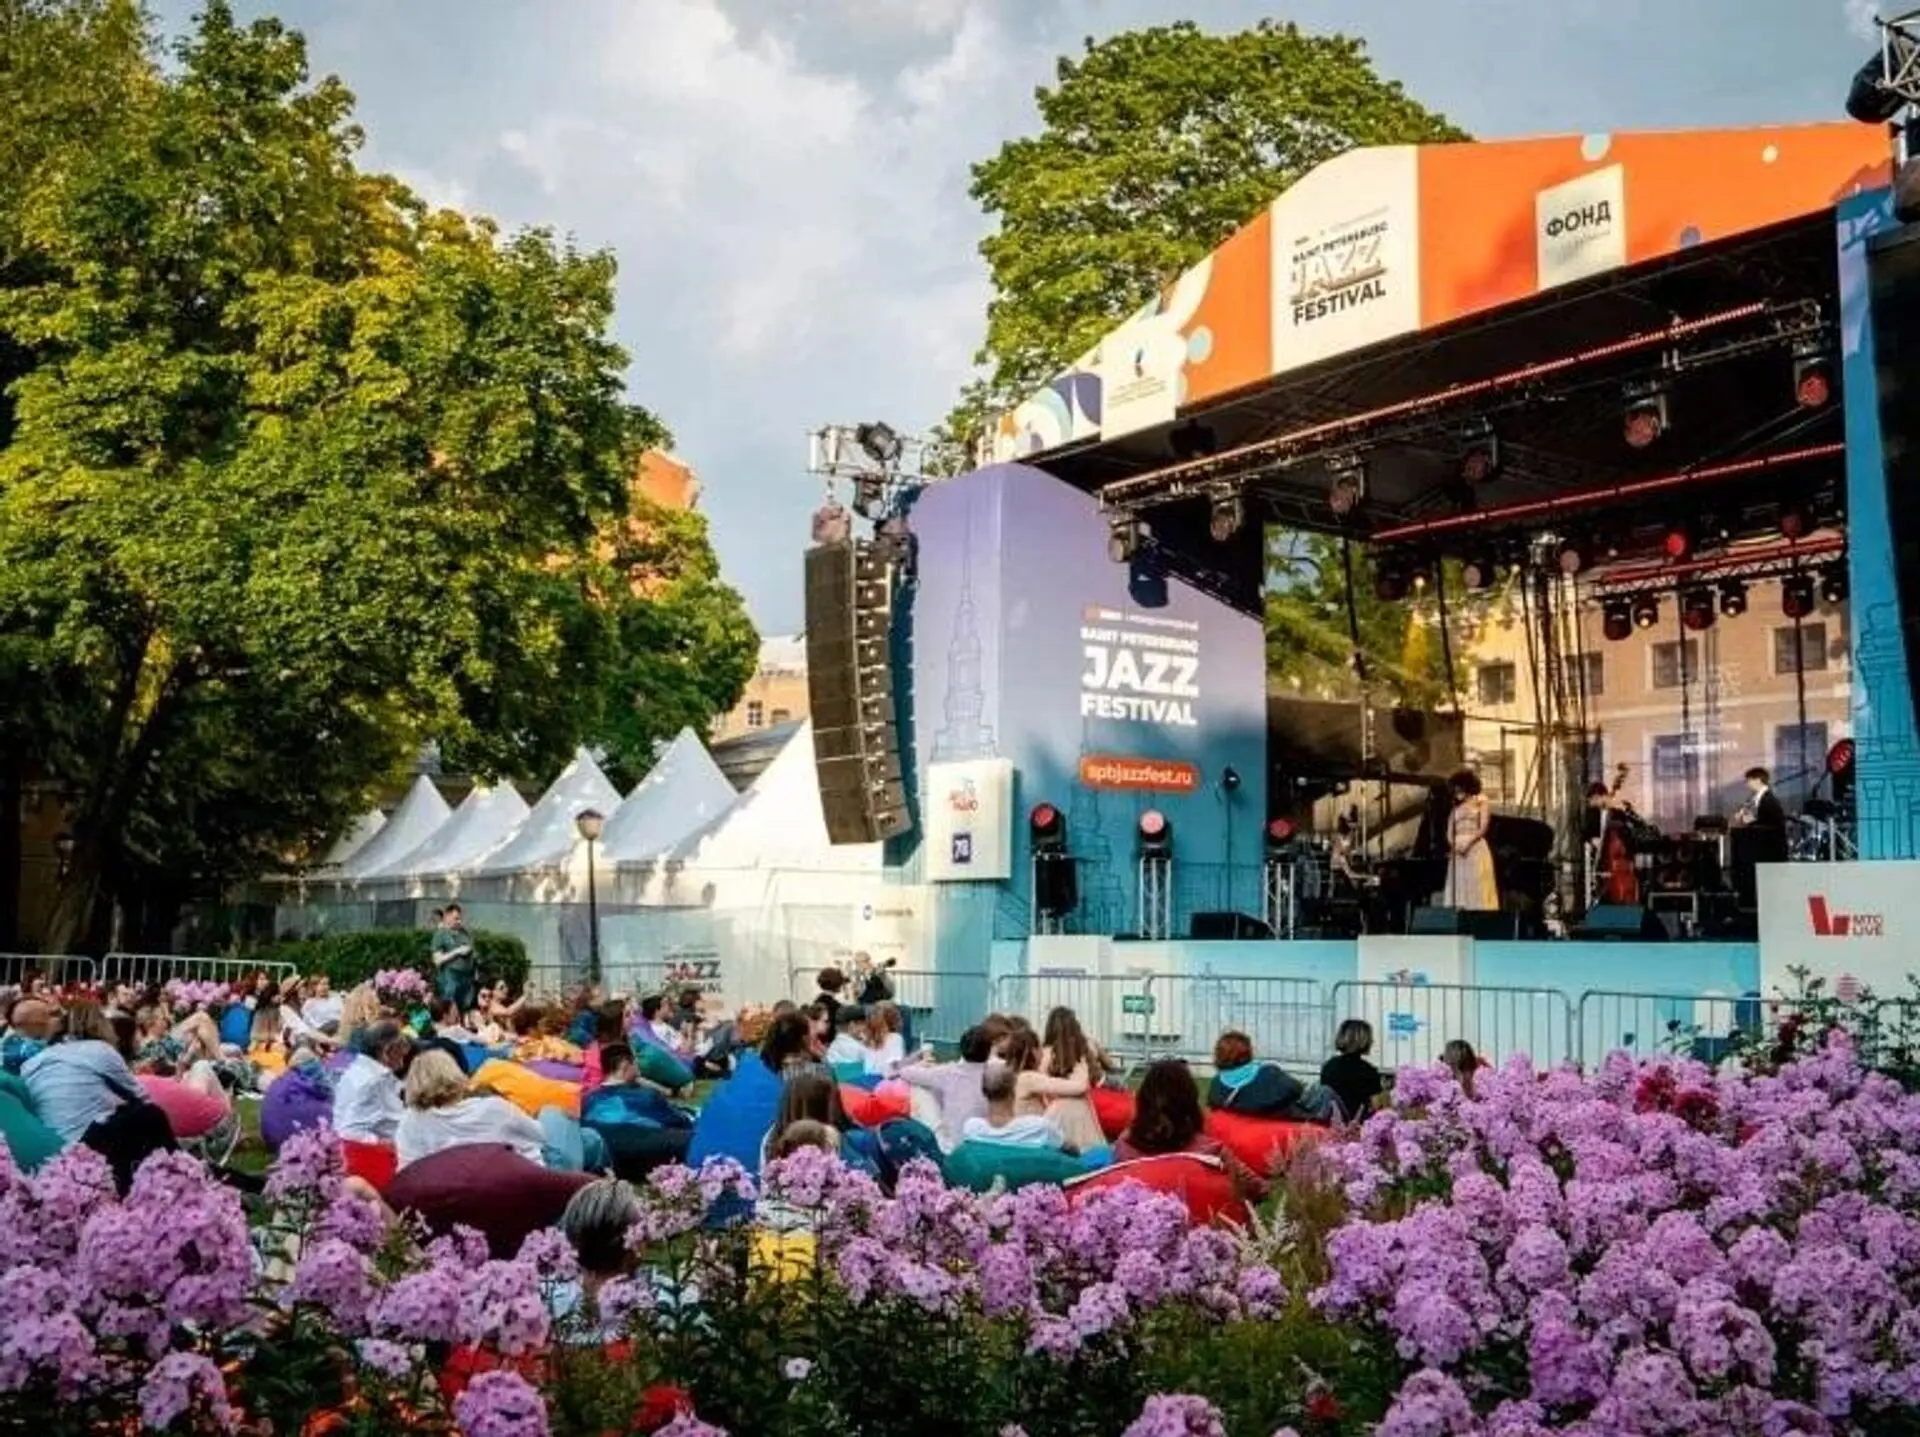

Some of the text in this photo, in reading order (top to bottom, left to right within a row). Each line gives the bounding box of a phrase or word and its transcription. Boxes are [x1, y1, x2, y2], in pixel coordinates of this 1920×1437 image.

[1547, 200, 1611, 237] ФОНД
[1290, 234, 1387, 305] JAZZ
[1293, 280, 1386, 327] FESTIVAL
[1082, 645, 1199, 697] JAZZ
[1080, 692, 1198, 726] FESTIVAL
